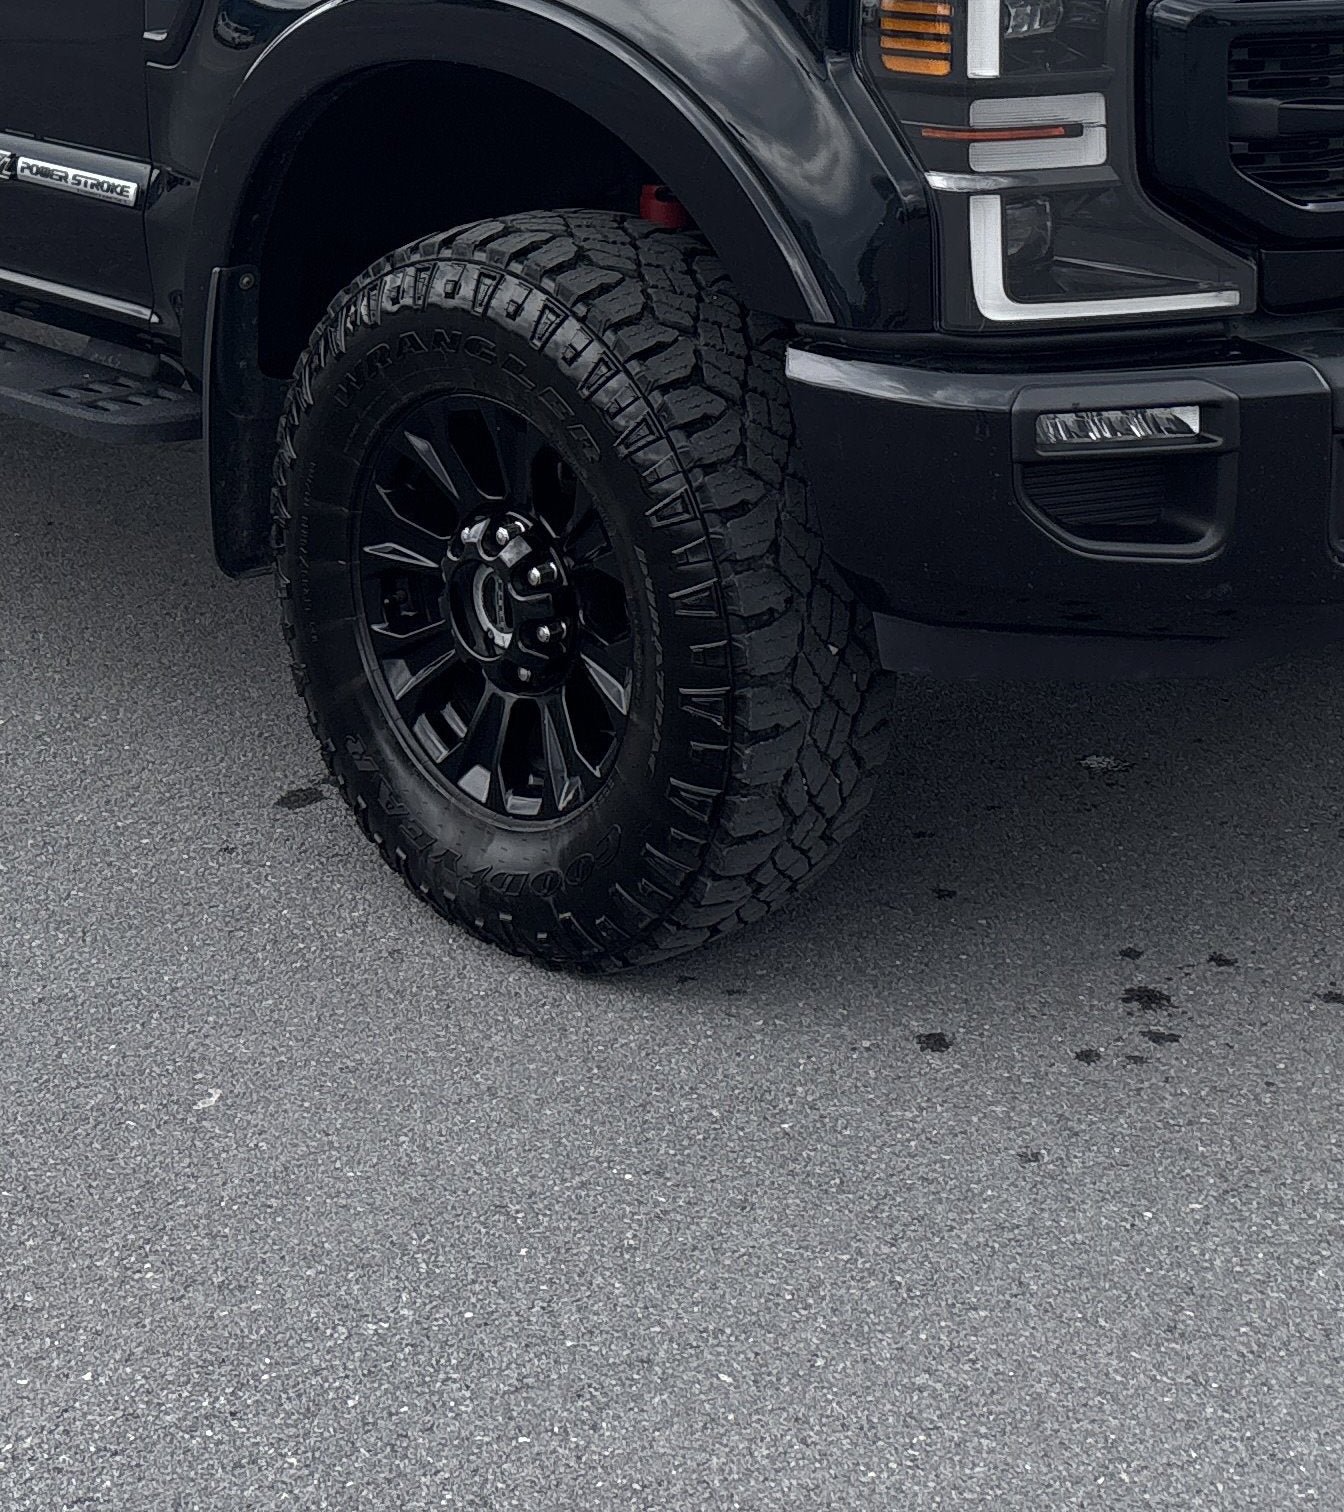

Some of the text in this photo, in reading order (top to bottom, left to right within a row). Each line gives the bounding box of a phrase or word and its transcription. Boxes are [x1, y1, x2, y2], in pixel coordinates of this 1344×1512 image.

[19, 160, 70, 185] POWER
[70, 173, 132, 199] STROKE
[333, 328, 602, 464] WRANGLER
